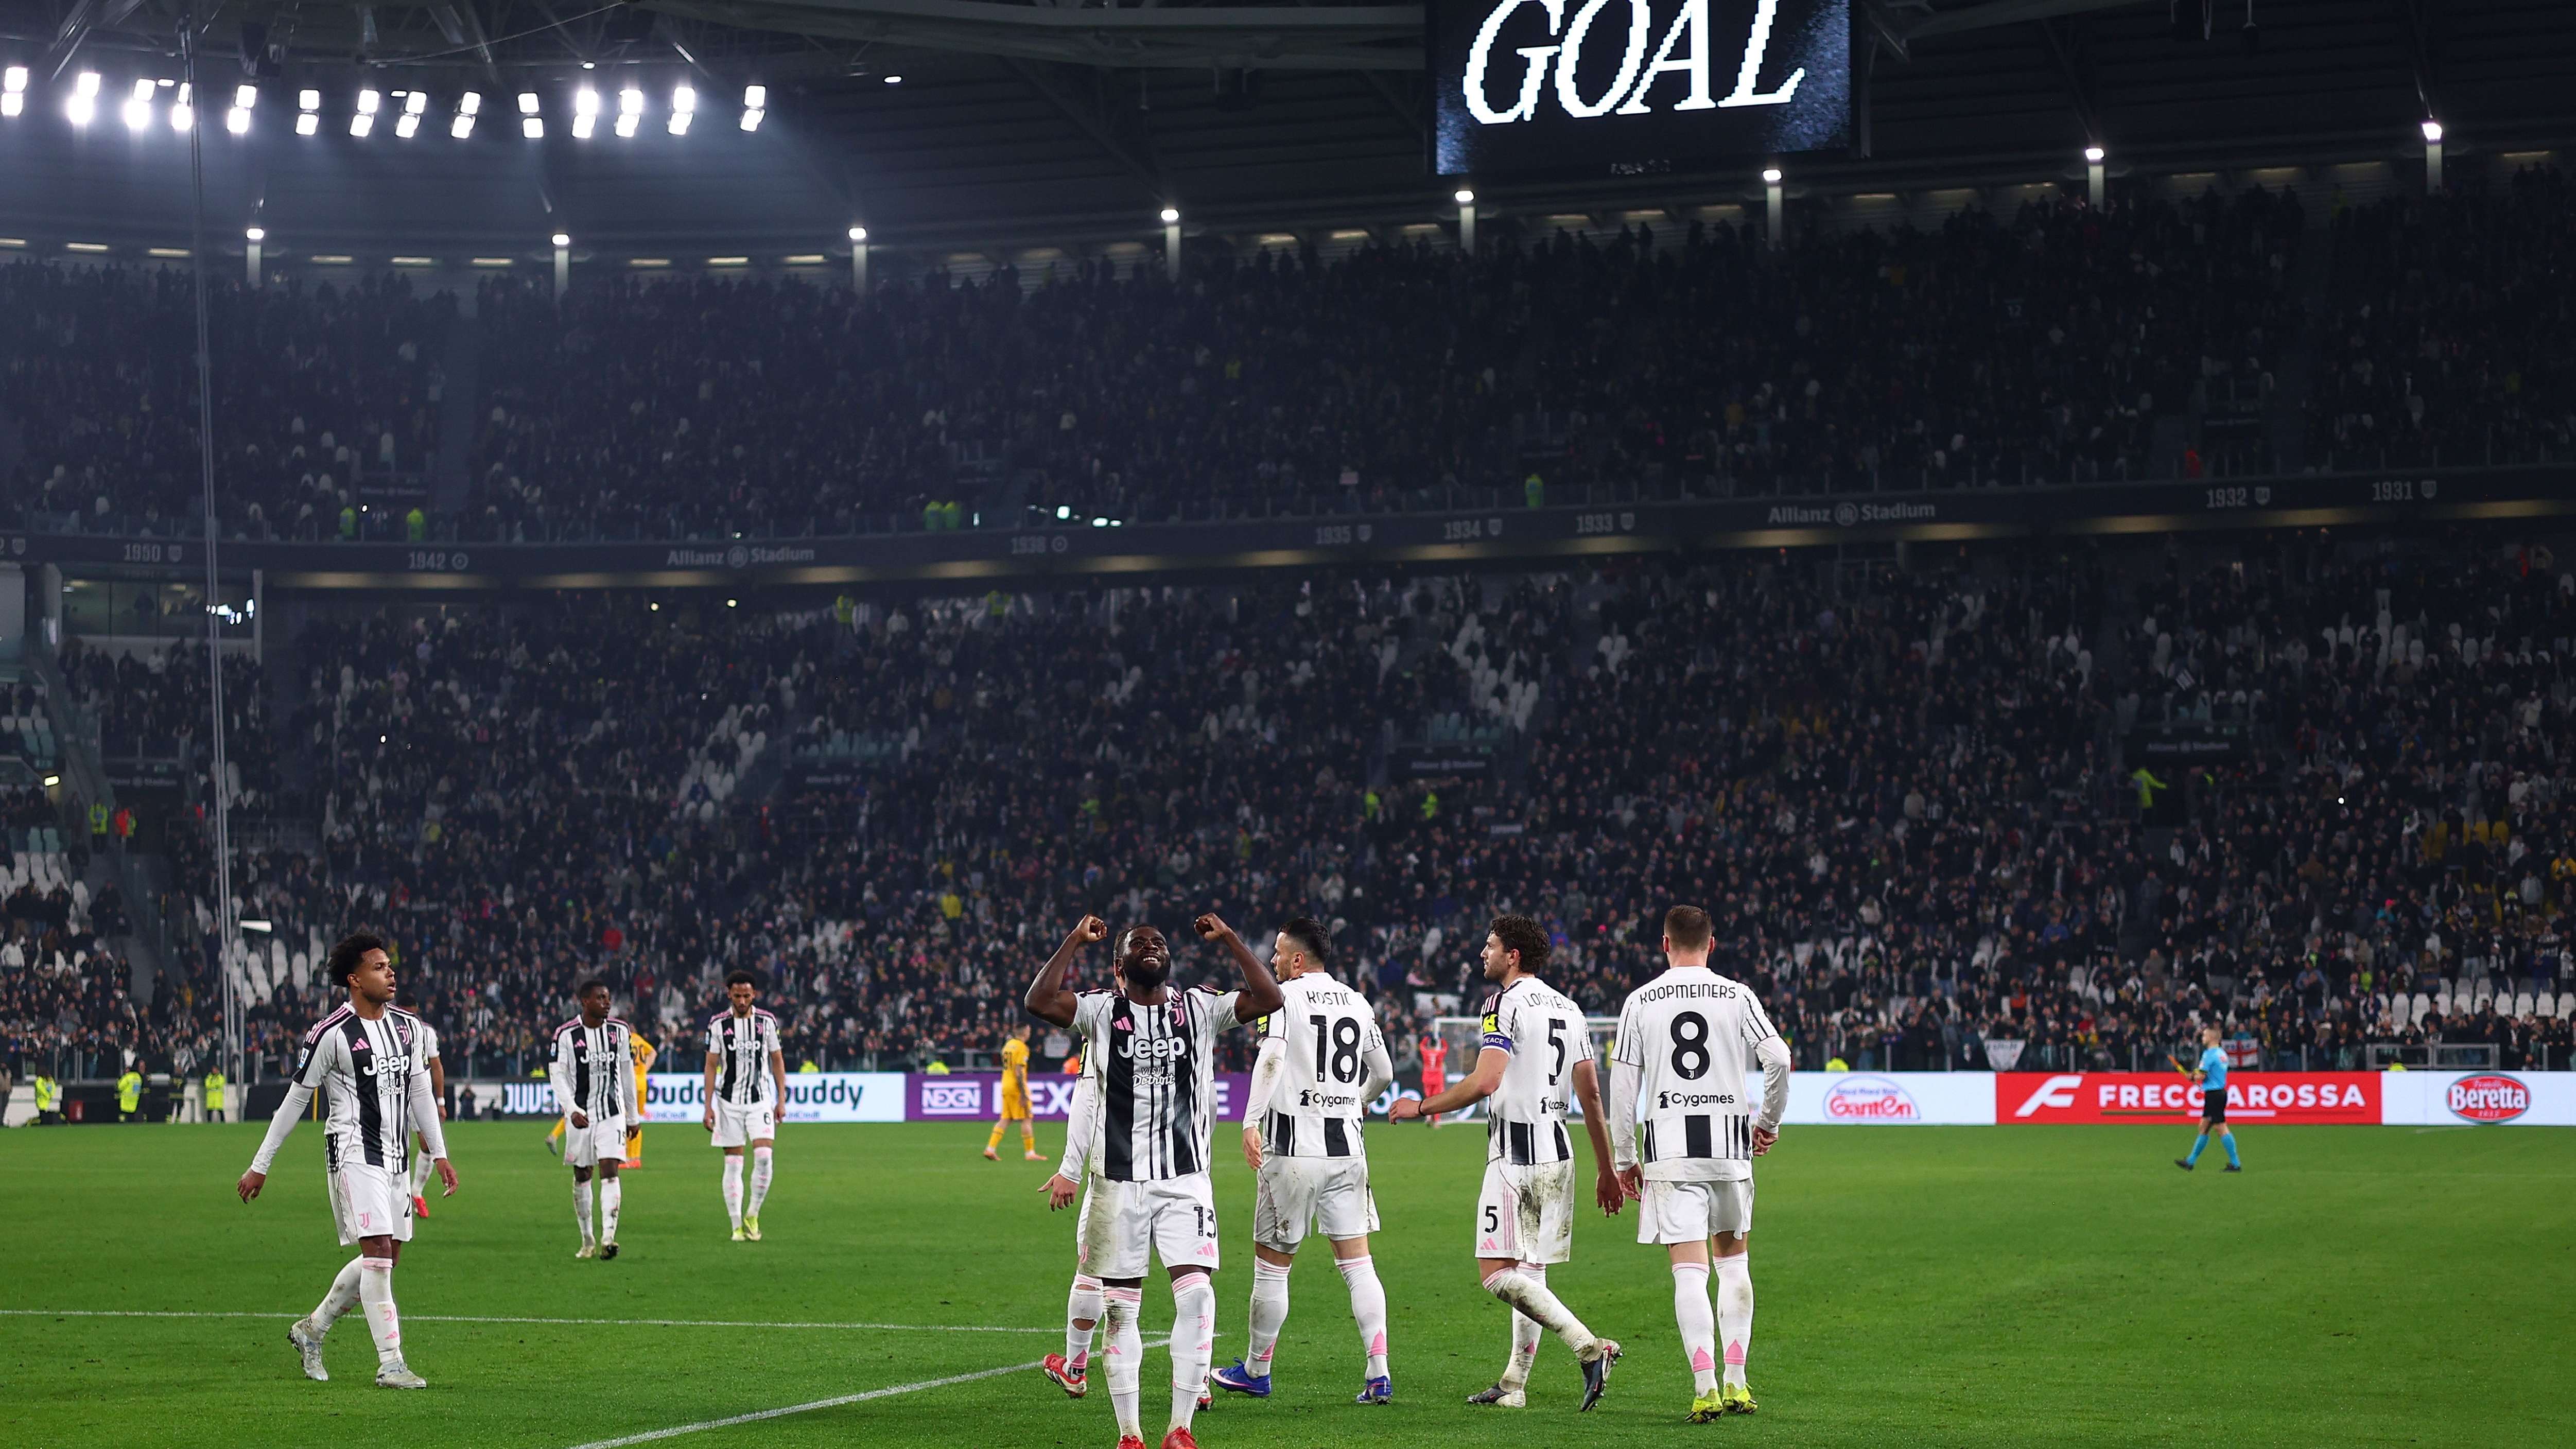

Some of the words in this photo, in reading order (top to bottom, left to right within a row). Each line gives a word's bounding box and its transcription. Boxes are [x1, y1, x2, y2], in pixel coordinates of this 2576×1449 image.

[1463, 0, 1805, 124] GOAL
[2205, 487, 2248, 508] 1932
[2372, 481, 2413, 501] 1931
[1768, 505, 1832, 523] Allianz
[1861, 502, 1936, 521] Stadium
[1444, 520, 1482, 540] 1934
[667, 550, 724, 566] Allianz
[751, 546, 815, 563] Stadium
[1640, 984, 1736, 1005] KOOPMEINERS
[727, 1038, 761, 1053] Jeep
[1117, 1035, 1186, 1062] Jeep
[1310, 1015, 1360, 1084] 18
[1483, 1037, 1504, 1045] PEACE
[1670, 1010, 1710, 1080] 8
[580, 1050, 616, 1065] Jeep
[1548, 1018, 1567, 1086] 5
[362, 1054, 410, 1076] Jeep
[1141, 1067, 1164, 1075] VISIT
[1132, 1072, 1176, 1088] Detroit
[923, 1088, 981, 1107] NEXEN
[1671, 1092, 1735, 1107] Cygames
[2098, 1084, 2366, 1108] FRECCAROSSA
[2451, 1084, 2527, 1111] Beretta
[763, 1112, 771, 1125] 6
[1193, 1206, 1216, 1239] 13
[1484, 1205, 1499, 1233] 5
